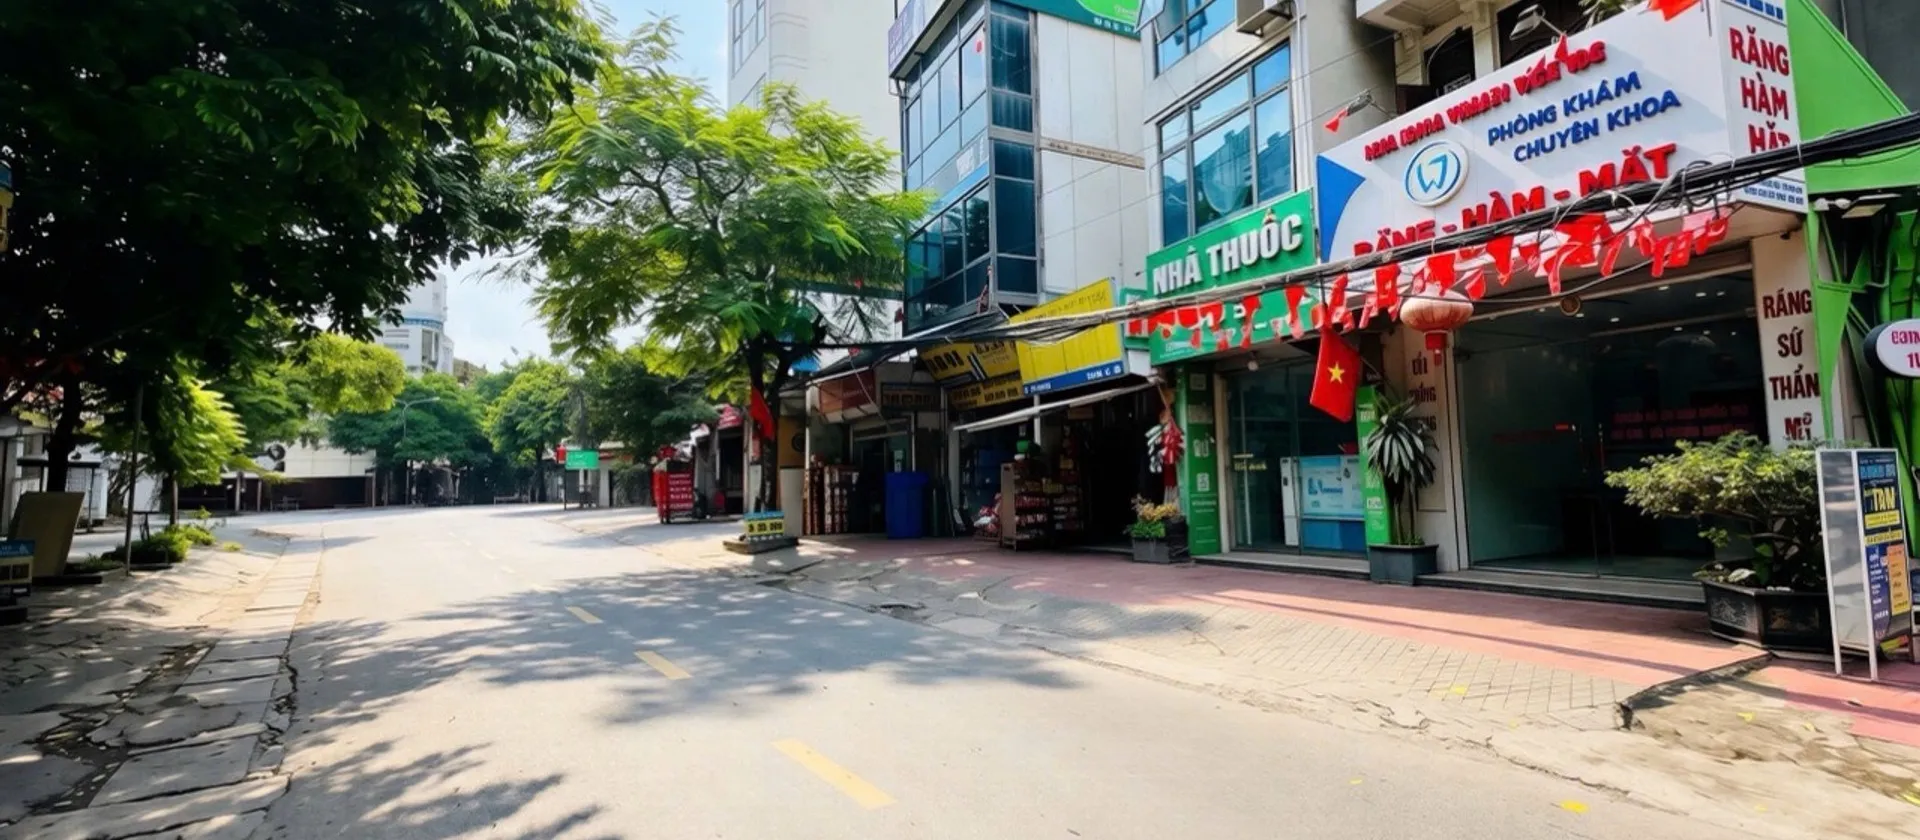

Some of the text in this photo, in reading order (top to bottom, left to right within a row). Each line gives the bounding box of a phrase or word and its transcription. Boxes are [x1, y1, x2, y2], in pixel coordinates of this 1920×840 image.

[1488, 104, 1557, 146] PHÒNG
[1563, 71, 1642, 117] KHÁM
[1513, 90, 1682, 162] CHUYÊN KHOA
[1740, 72, 1789, 121] HÀM
